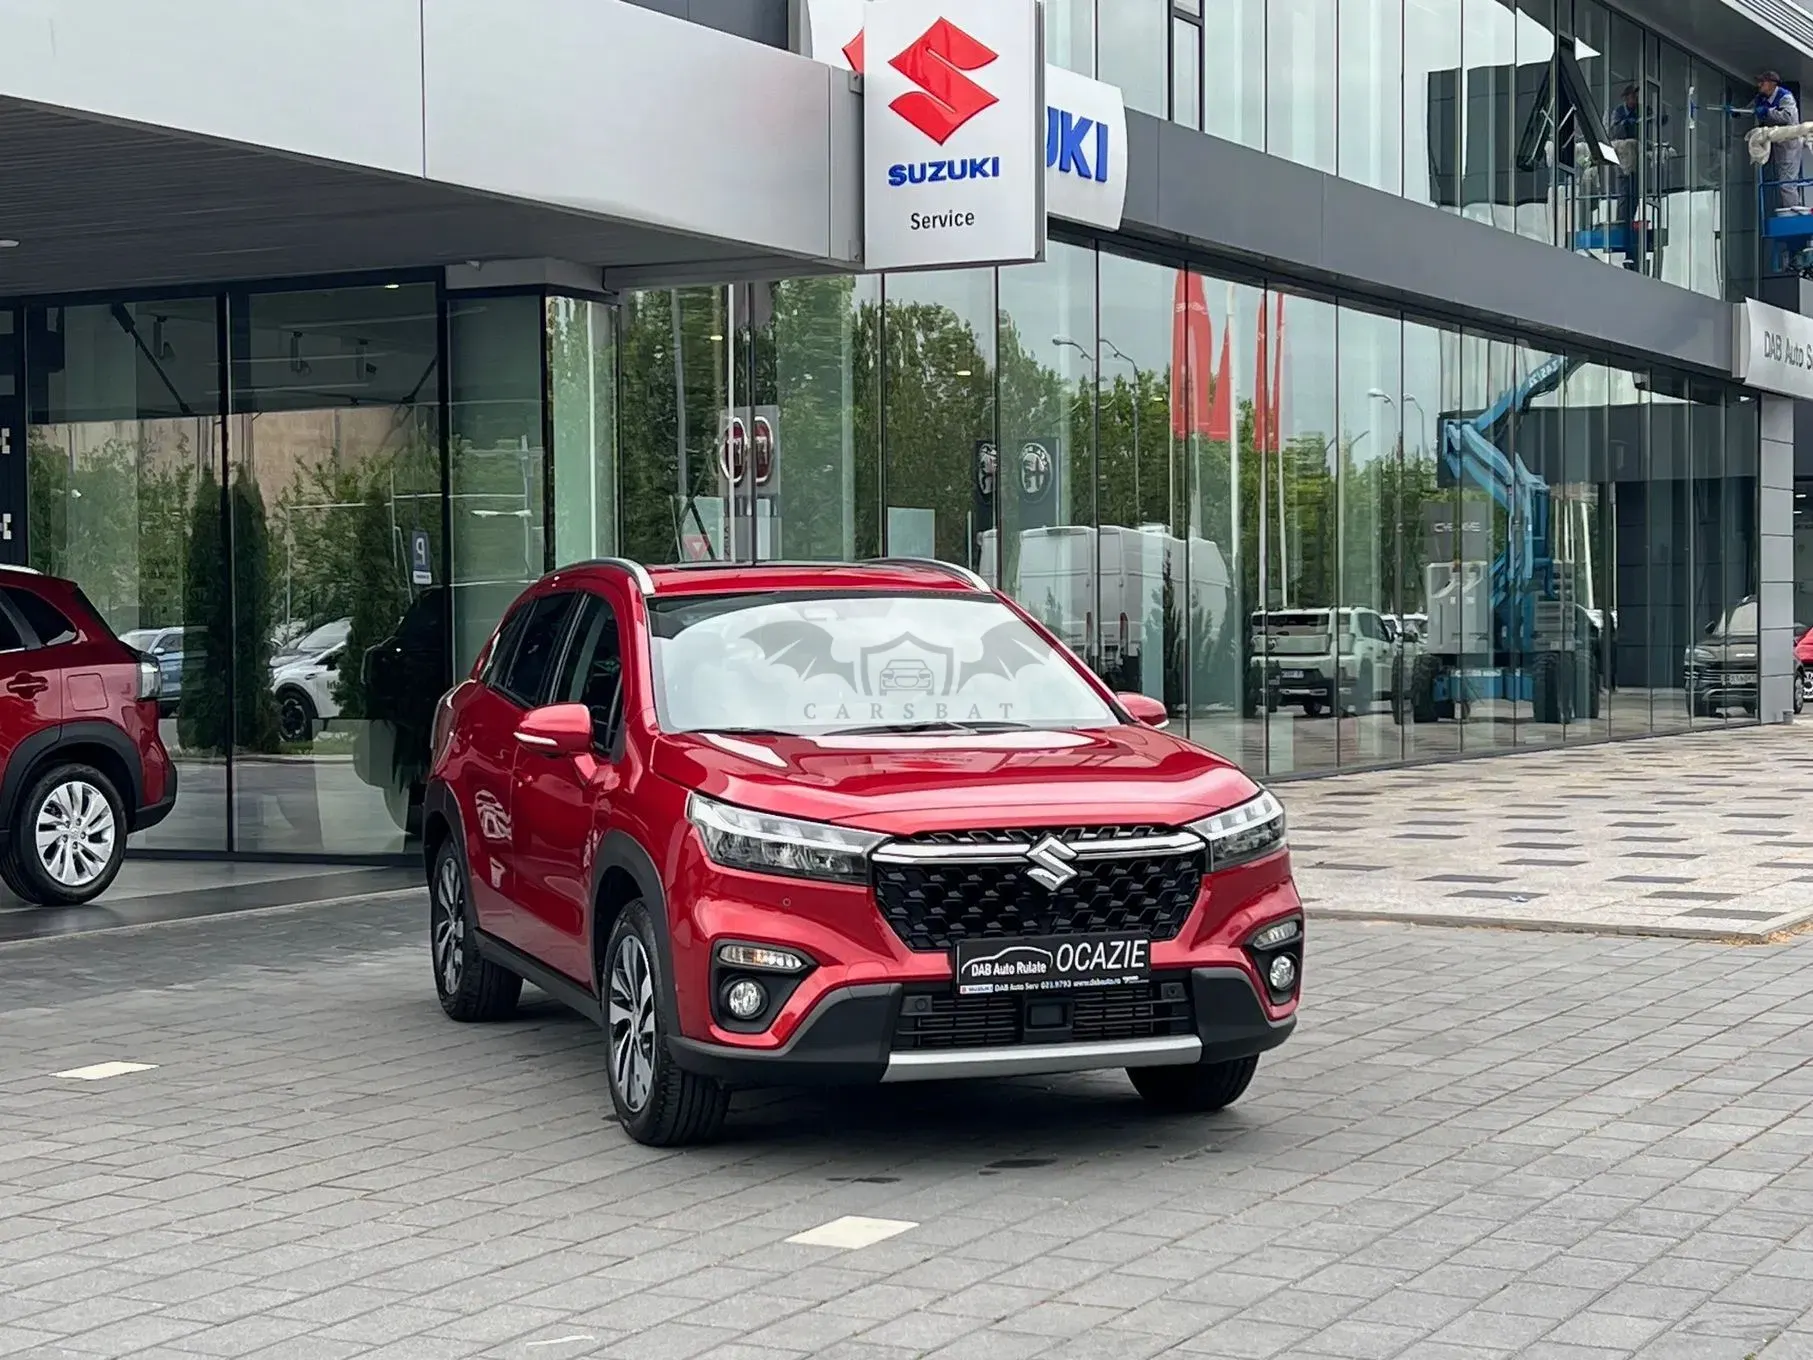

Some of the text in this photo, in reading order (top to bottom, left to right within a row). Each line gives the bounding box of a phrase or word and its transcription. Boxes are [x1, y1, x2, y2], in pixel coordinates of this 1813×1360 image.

[888, 156, 1000, 186] SUZUKI
[910, 209, 975, 230] Service
[1764, 331, 1782, 361] DAB
[1785, 338, 1804, 368] Auto
[1056, 939, 1148, 972] OCAZIE
[971, 960, 1047, 977] DAB Auto Rulate
[994, 984, 1009, 992] DAB
[1010, 983, 1024, 991] Auto
[1025, 982, 1039, 990] Serv
